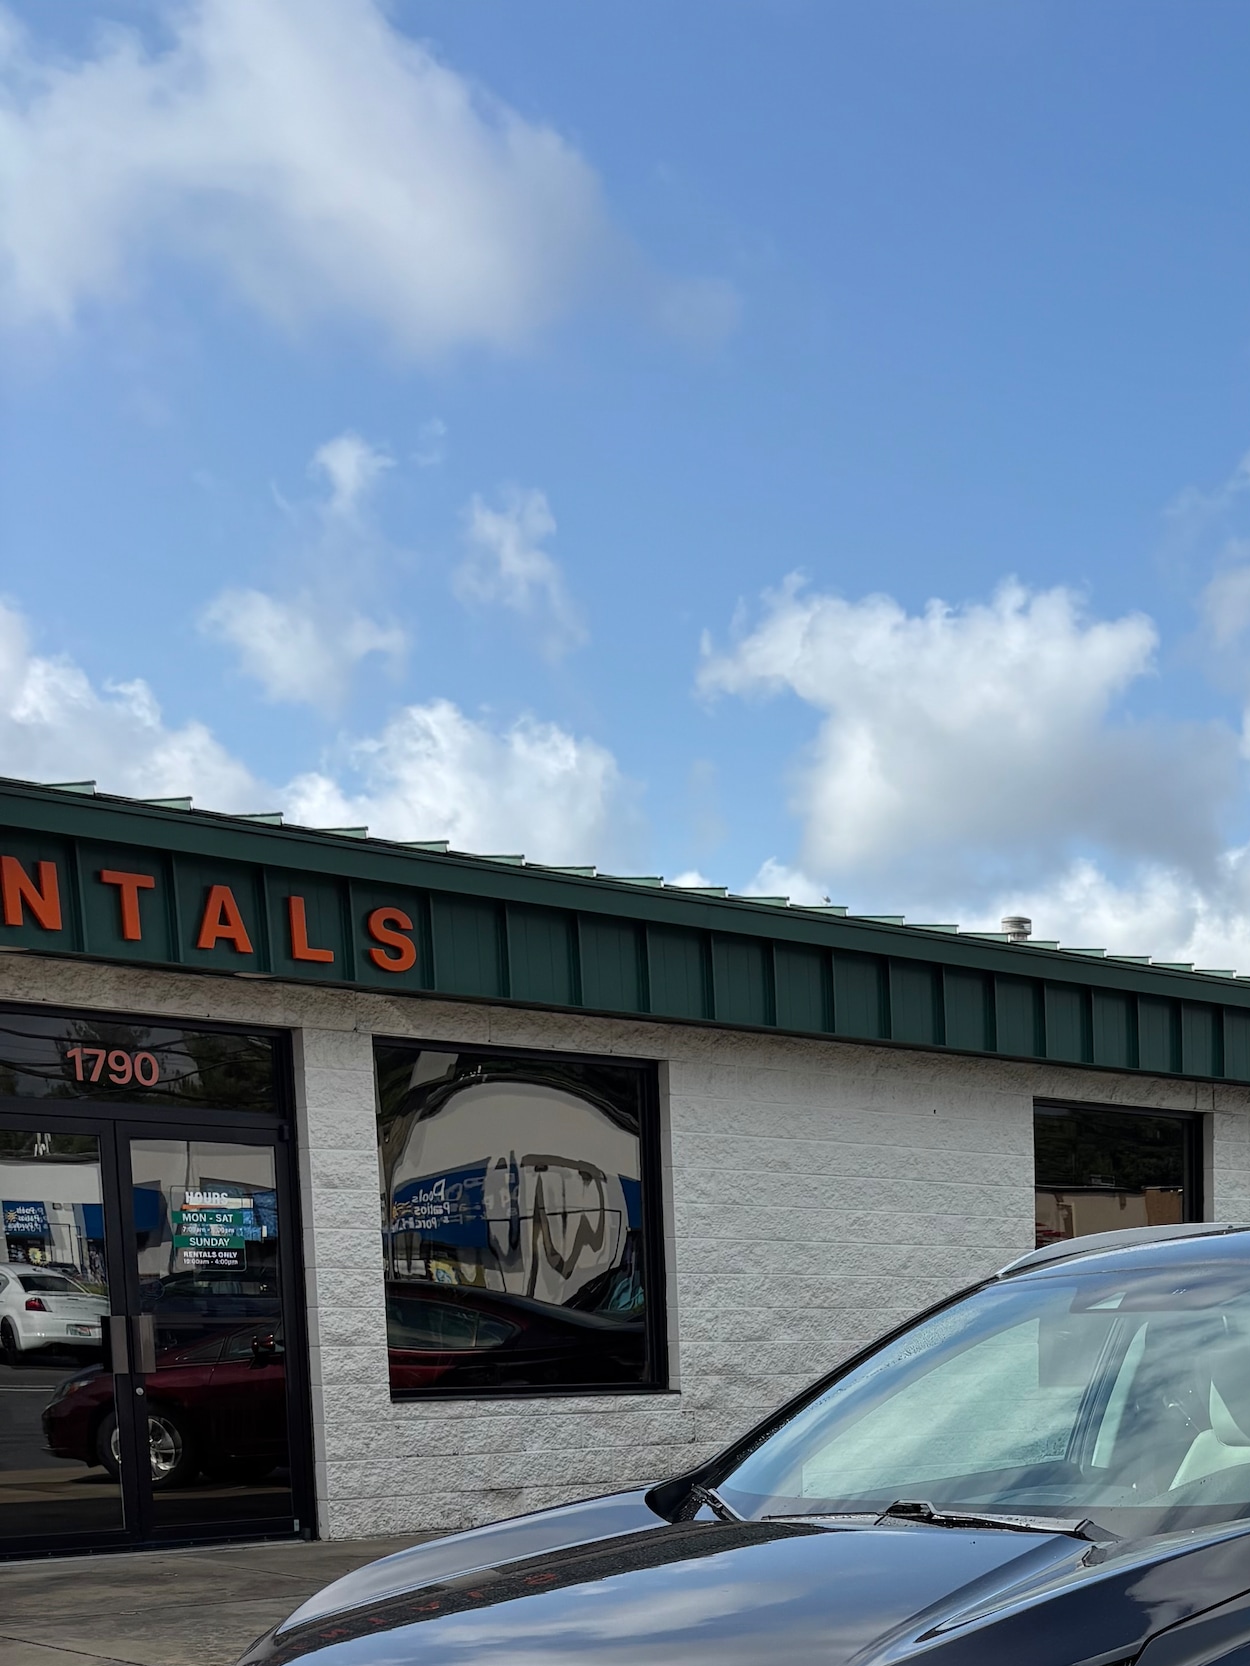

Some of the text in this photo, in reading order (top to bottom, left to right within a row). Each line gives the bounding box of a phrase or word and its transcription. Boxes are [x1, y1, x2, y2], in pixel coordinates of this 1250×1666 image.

[0, 855, 417, 973] NTALS
[66, 1047, 160, 1087] 1790
[185, 1191, 229, 1205] HOURS
[182, 1213, 207, 1223] MON
[215, 1213, 234, 1223] SAT
[189, 1237, 230, 1247] SUNDAY
